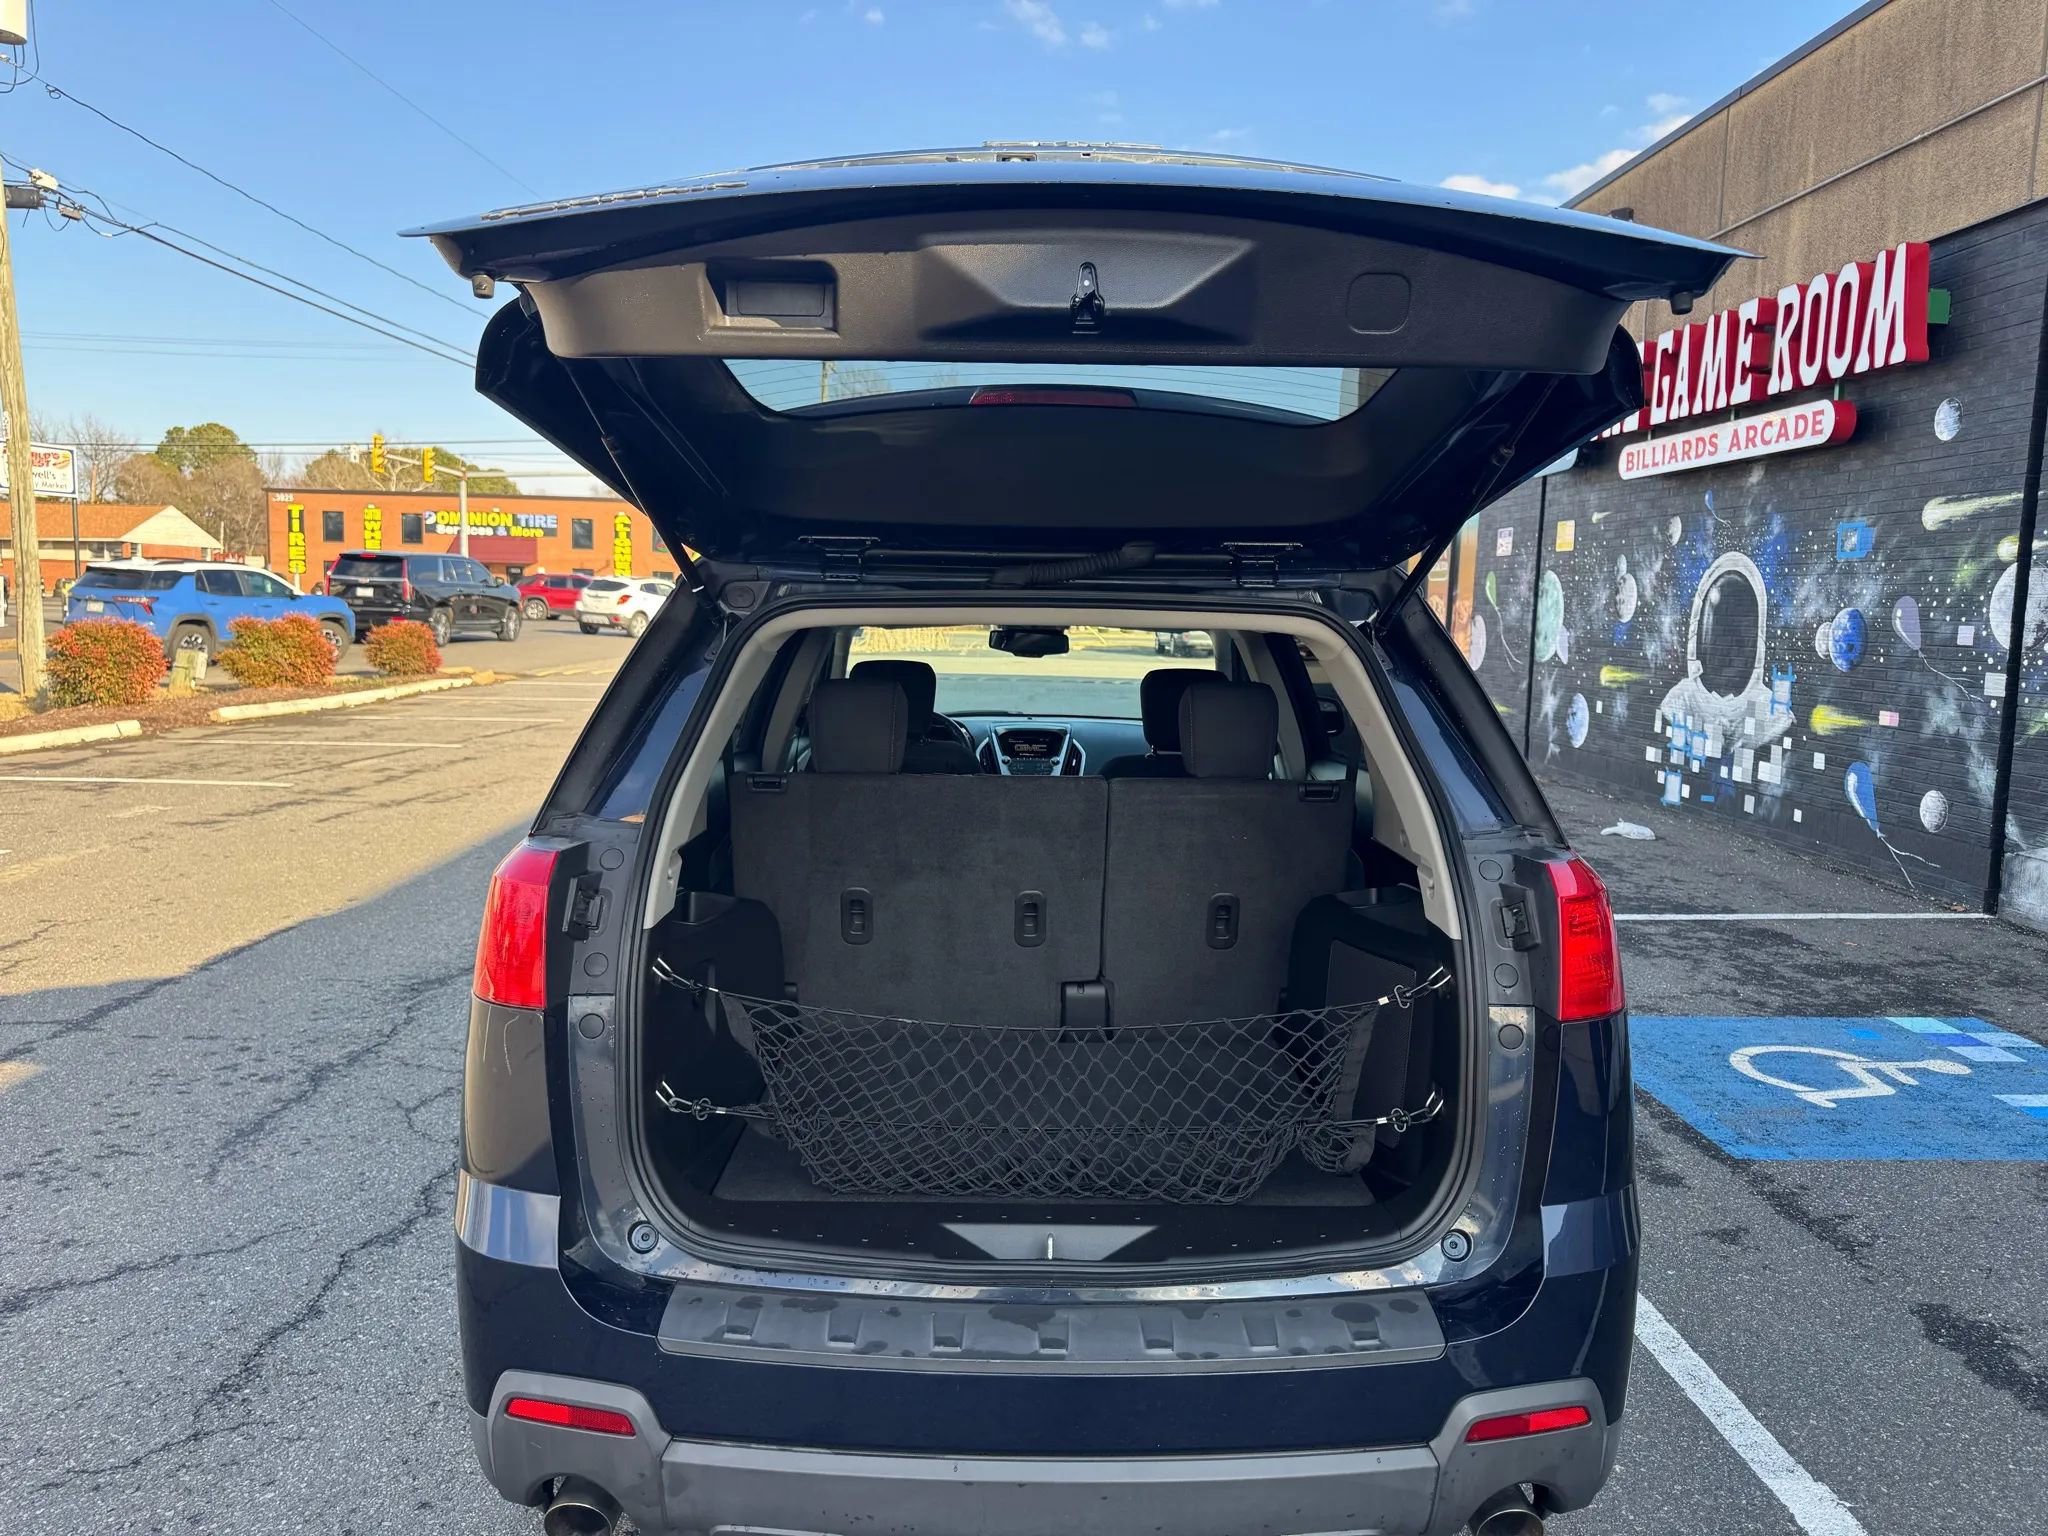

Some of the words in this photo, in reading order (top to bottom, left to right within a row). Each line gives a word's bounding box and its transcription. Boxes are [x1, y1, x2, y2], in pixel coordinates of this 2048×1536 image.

[1650, 297, 1759, 425] GAME
[1767, 242, 1907, 396] ROOM
[1625, 432, 1719, 473] BILLIARDS
[1727, 409, 1825, 453] ARCADE
[287, 504, 306, 574] TIRES
[496, 526, 507, 536] &
[510, 526, 545, 537] More
[517, 514, 558, 528] TIRE
[1014, 743, 1048, 752] GMC
